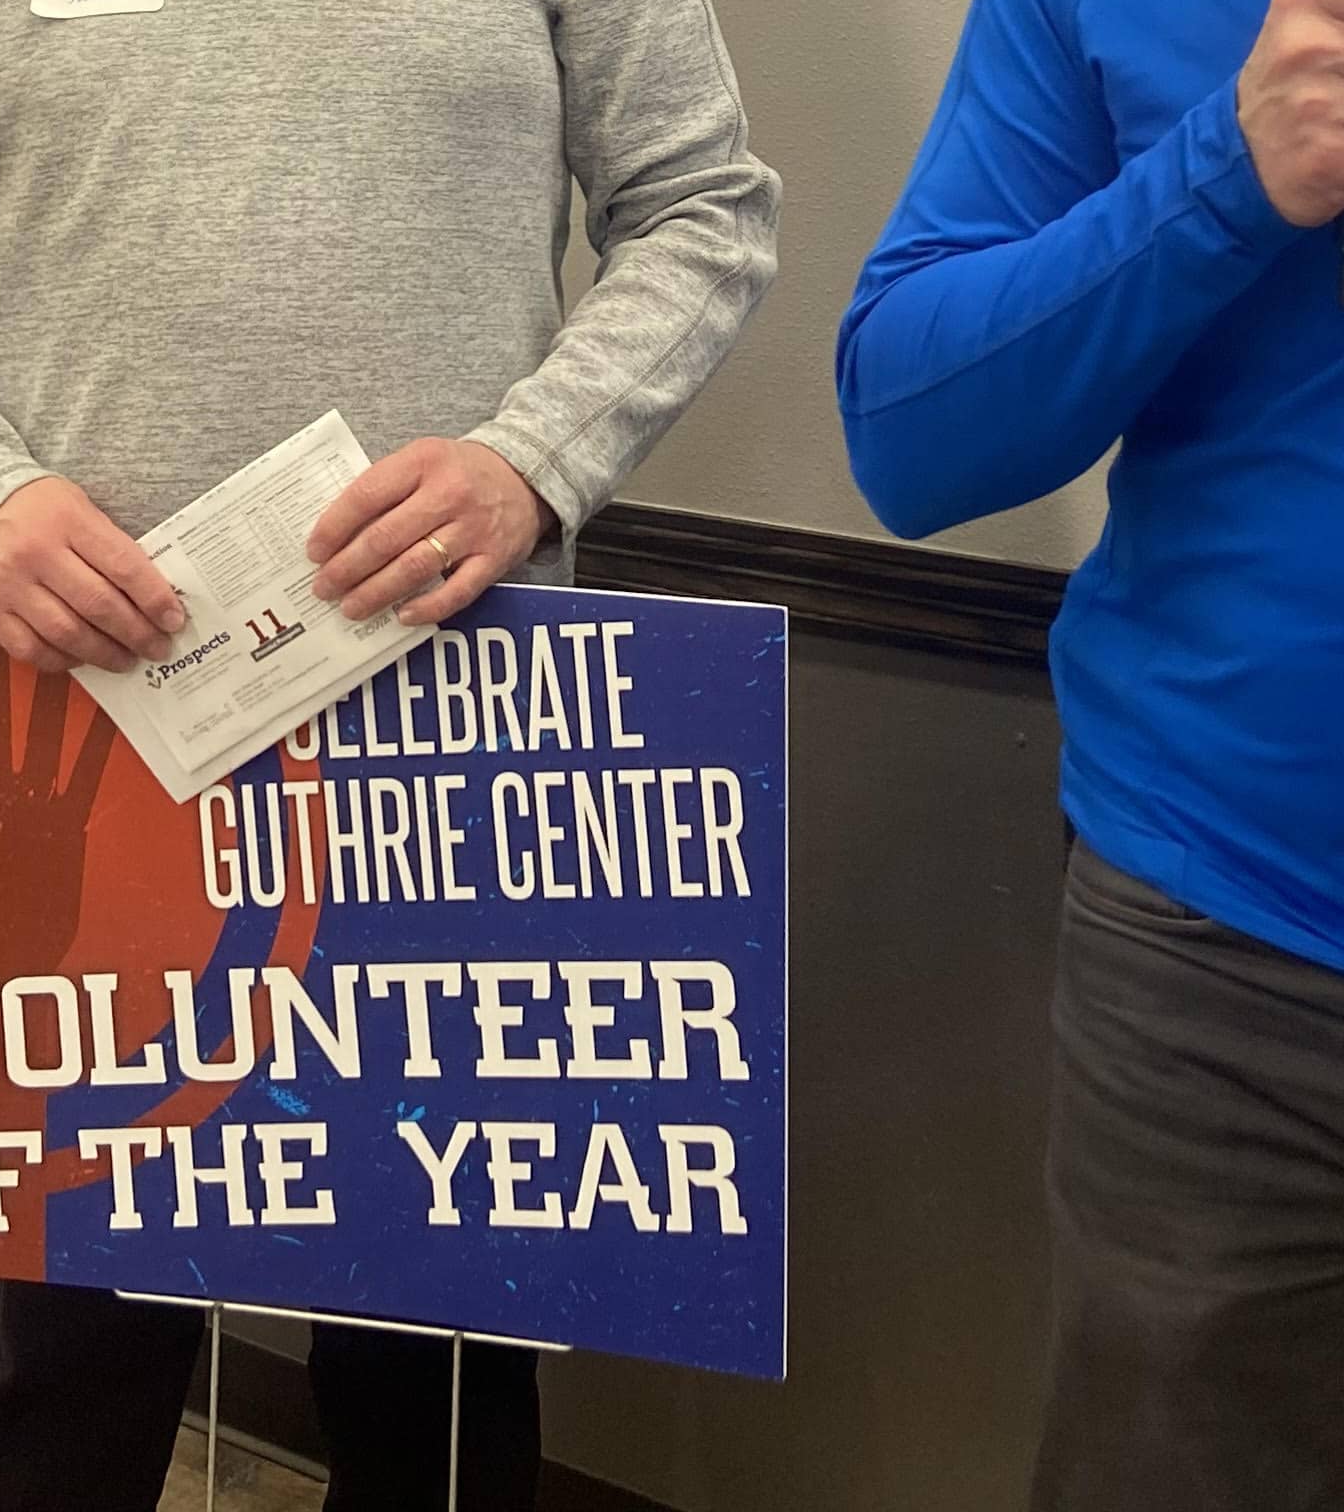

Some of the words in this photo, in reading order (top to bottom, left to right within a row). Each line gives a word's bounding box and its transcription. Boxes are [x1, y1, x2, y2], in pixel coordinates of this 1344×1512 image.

[158, 631, 231, 680] Prospects
[198, 774, 476, 911] GUTHRIE
[491, 766, 752, 901] CENTER
[77, 1122, 336, 1230] THE
[397, 1121, 748, 1235] YEAR
